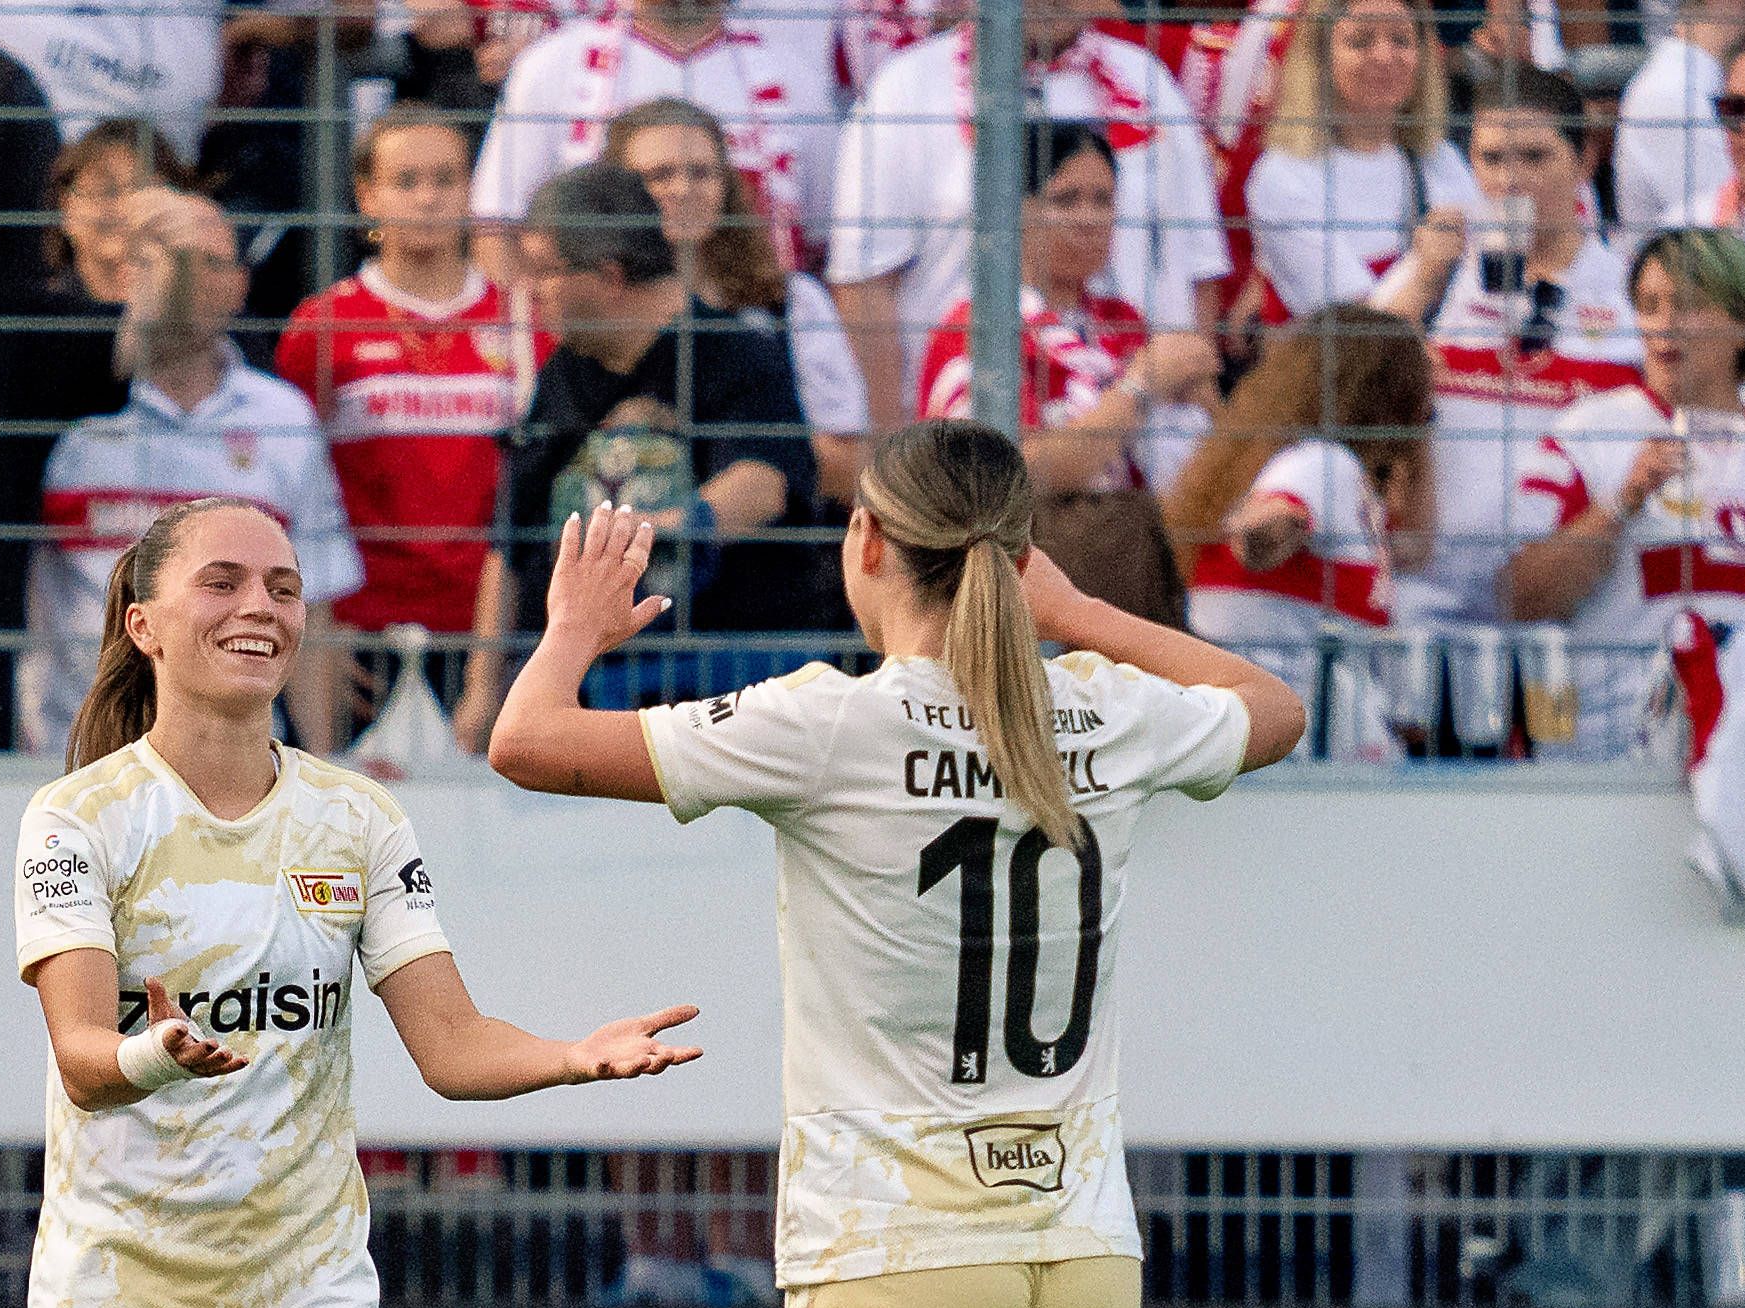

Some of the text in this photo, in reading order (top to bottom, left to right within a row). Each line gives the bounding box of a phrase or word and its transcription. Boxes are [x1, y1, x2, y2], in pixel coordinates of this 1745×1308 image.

[901, 699, 920, 722] 1.
[924, 704, 953, 730] FC
[1053, 708, 1105, 734] ERLIN
[905, 749, 1110, 799] CAMLL
[23, 853, 89, 879] Google
[32, 879, 79, 901] Pixel
[916, 815, 1103, 1084] 10
[179, 967, 341, 1033] raisin
[986, 1142, 1055, 1170] bella
